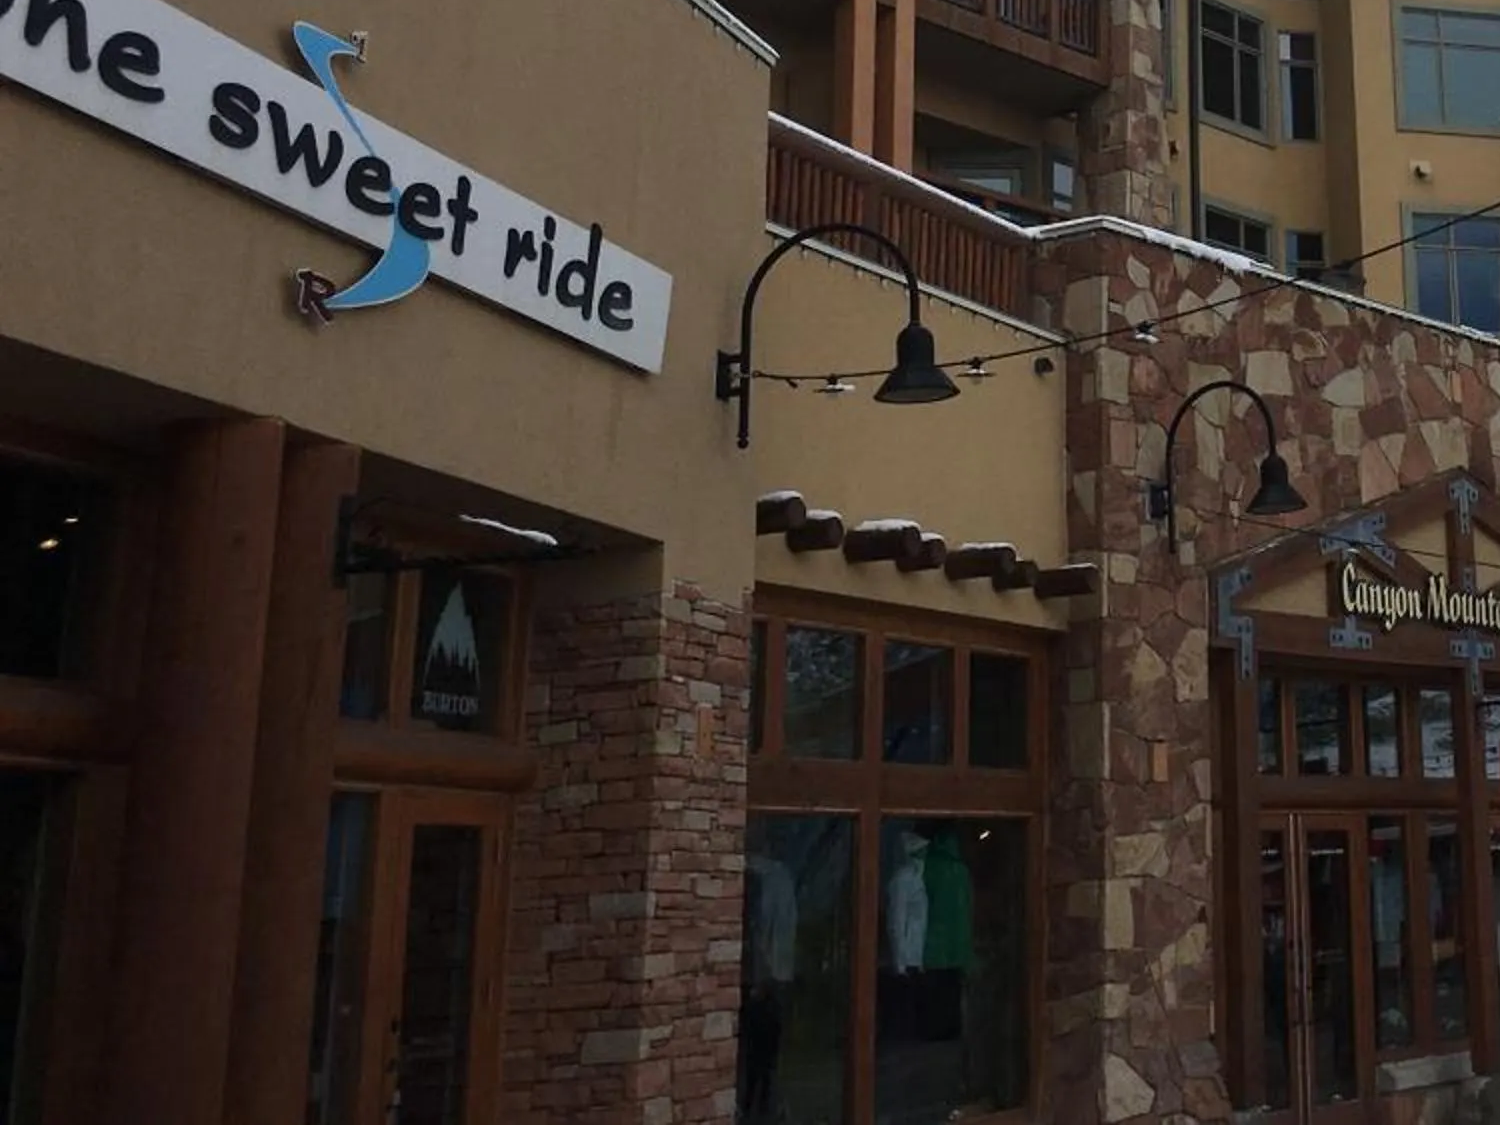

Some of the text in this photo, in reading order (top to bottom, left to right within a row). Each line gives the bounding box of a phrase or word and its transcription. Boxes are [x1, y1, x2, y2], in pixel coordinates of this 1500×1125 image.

[208, 82, 479, 256] sweet
[503, 215, 634, 332] ride
[1342, 561, 1423, 631] Canyon
